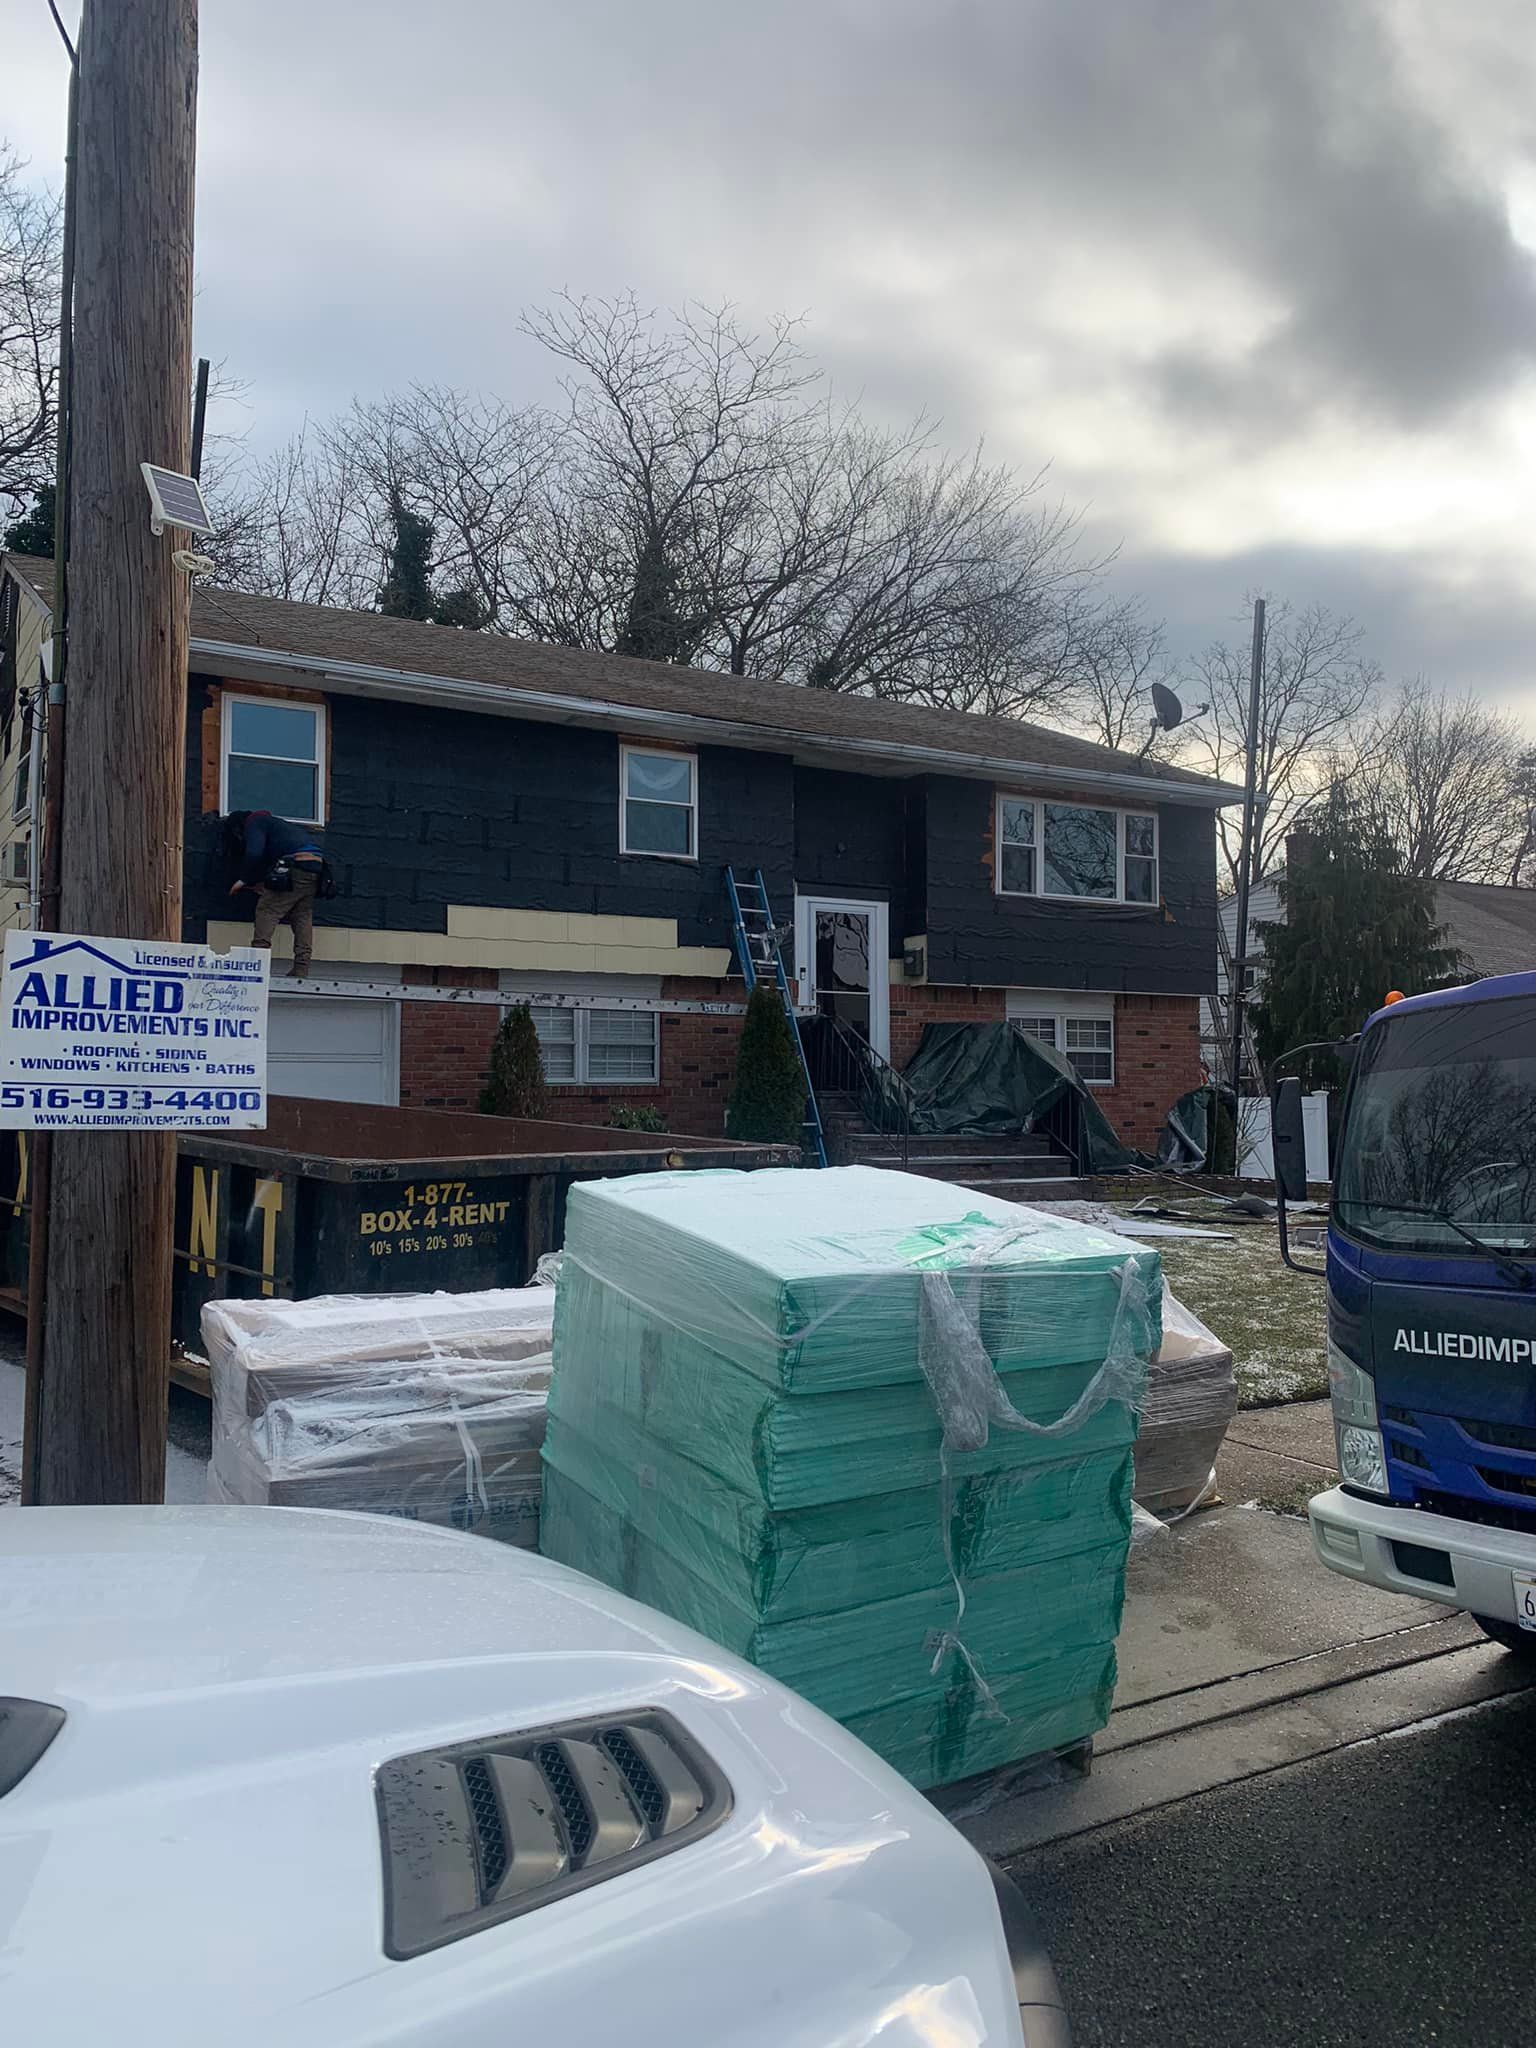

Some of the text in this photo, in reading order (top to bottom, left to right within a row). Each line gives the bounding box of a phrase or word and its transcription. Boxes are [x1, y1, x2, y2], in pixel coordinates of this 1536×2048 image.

[135, 951, 195, 968] Licensed
[13, 972, 184, 1014] ALLIED
[11, 1008, 259, 1039] IMPROVEMENTS INC.
[72, 1045, 207, 1061] ROOFING SIDING
[20, 1057, 256, 1075] WINDOWS KITCHENS BATHS
[1, 1087, 261, 1111] 516-933-4400
[404, 1182, 474, 1207] 1-877-
[369, 1239, 392, 1256] 10's
[398, 1237, 421, 1253] 15's
[426, 1235, 448, 1250] 20's
[452, 1232, 474, 1248] 30's
